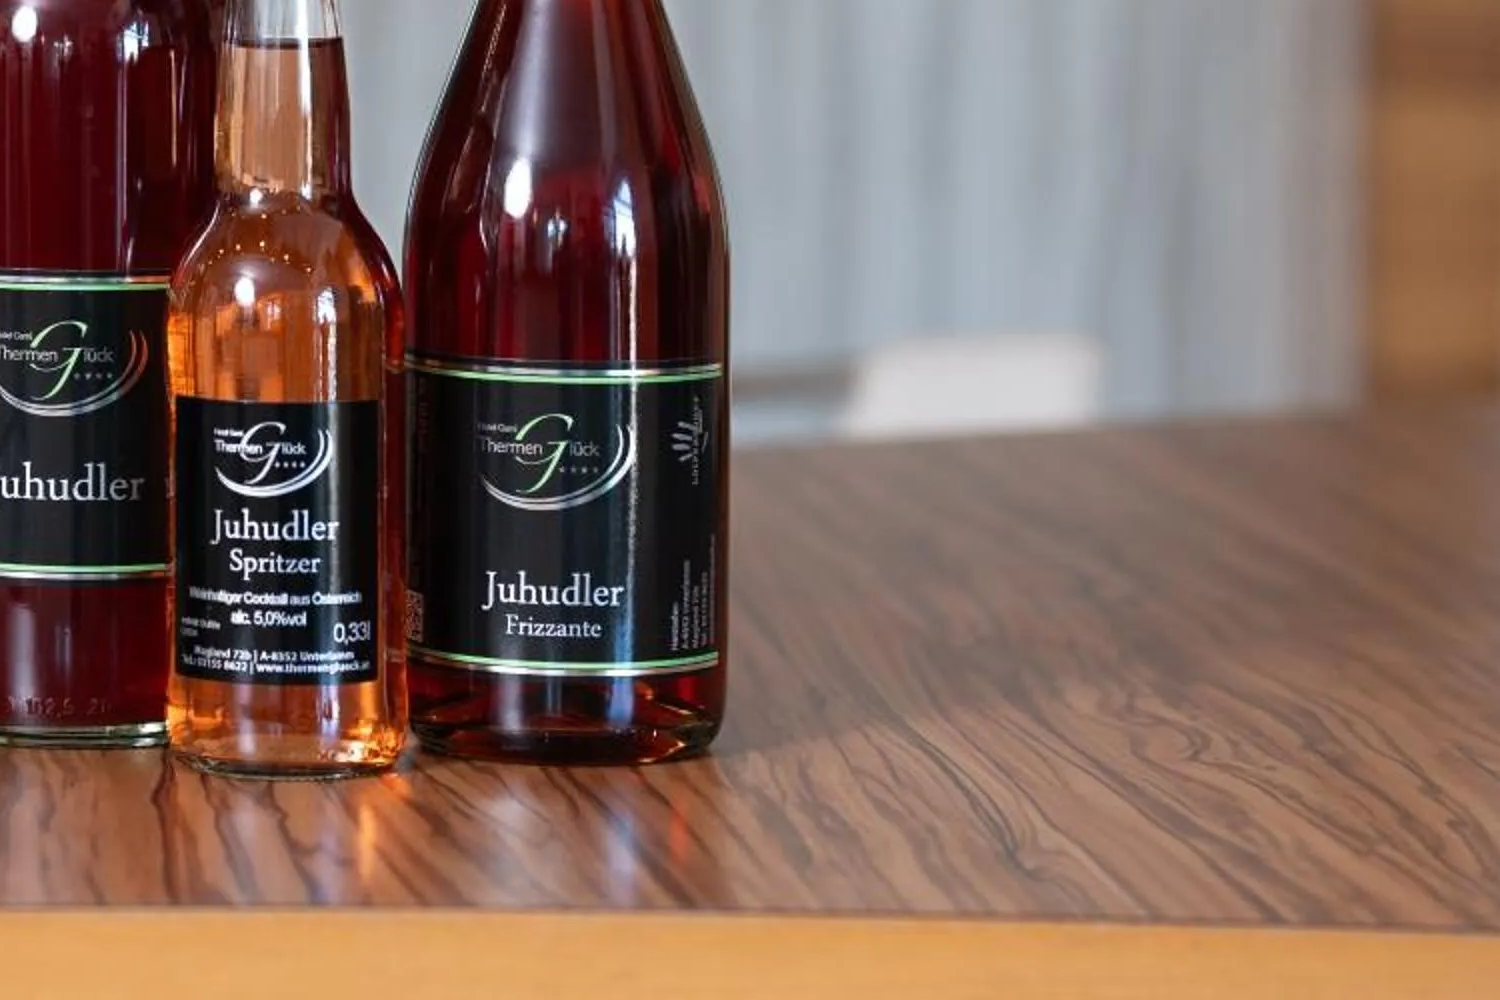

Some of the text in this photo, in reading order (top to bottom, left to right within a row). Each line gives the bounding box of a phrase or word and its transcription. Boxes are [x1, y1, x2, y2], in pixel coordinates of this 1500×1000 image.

[210, 508, 340, 545] Juhudler
[229, 548, 321, 581] Spritzer
[481, 569, 625, 611] Juhudler
[505, 612, 603, 638] Frizzante
